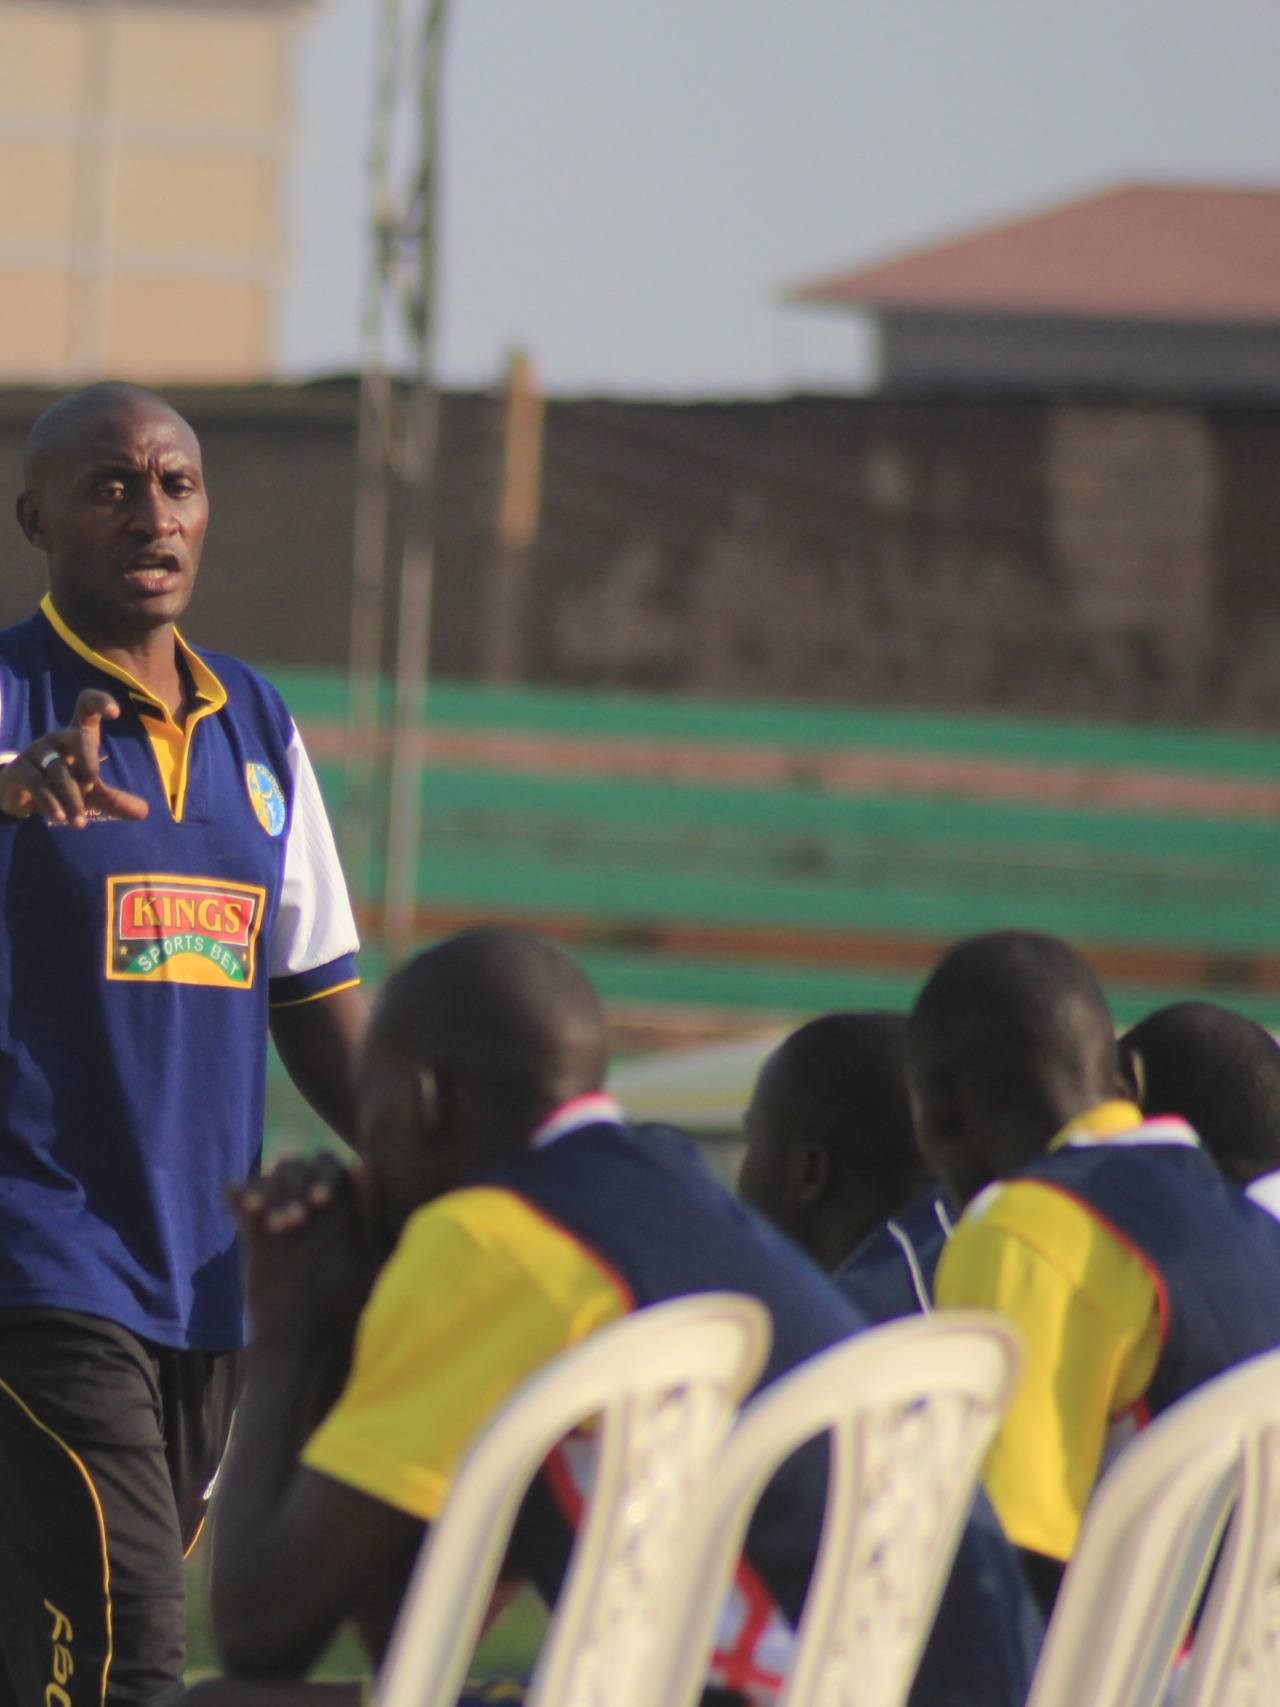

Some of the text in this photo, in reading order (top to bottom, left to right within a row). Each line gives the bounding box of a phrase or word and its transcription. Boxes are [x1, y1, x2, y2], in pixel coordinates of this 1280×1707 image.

[133, 896, 242, 933] KINGS
[138, 935, 239, 976] SPORTS BET
